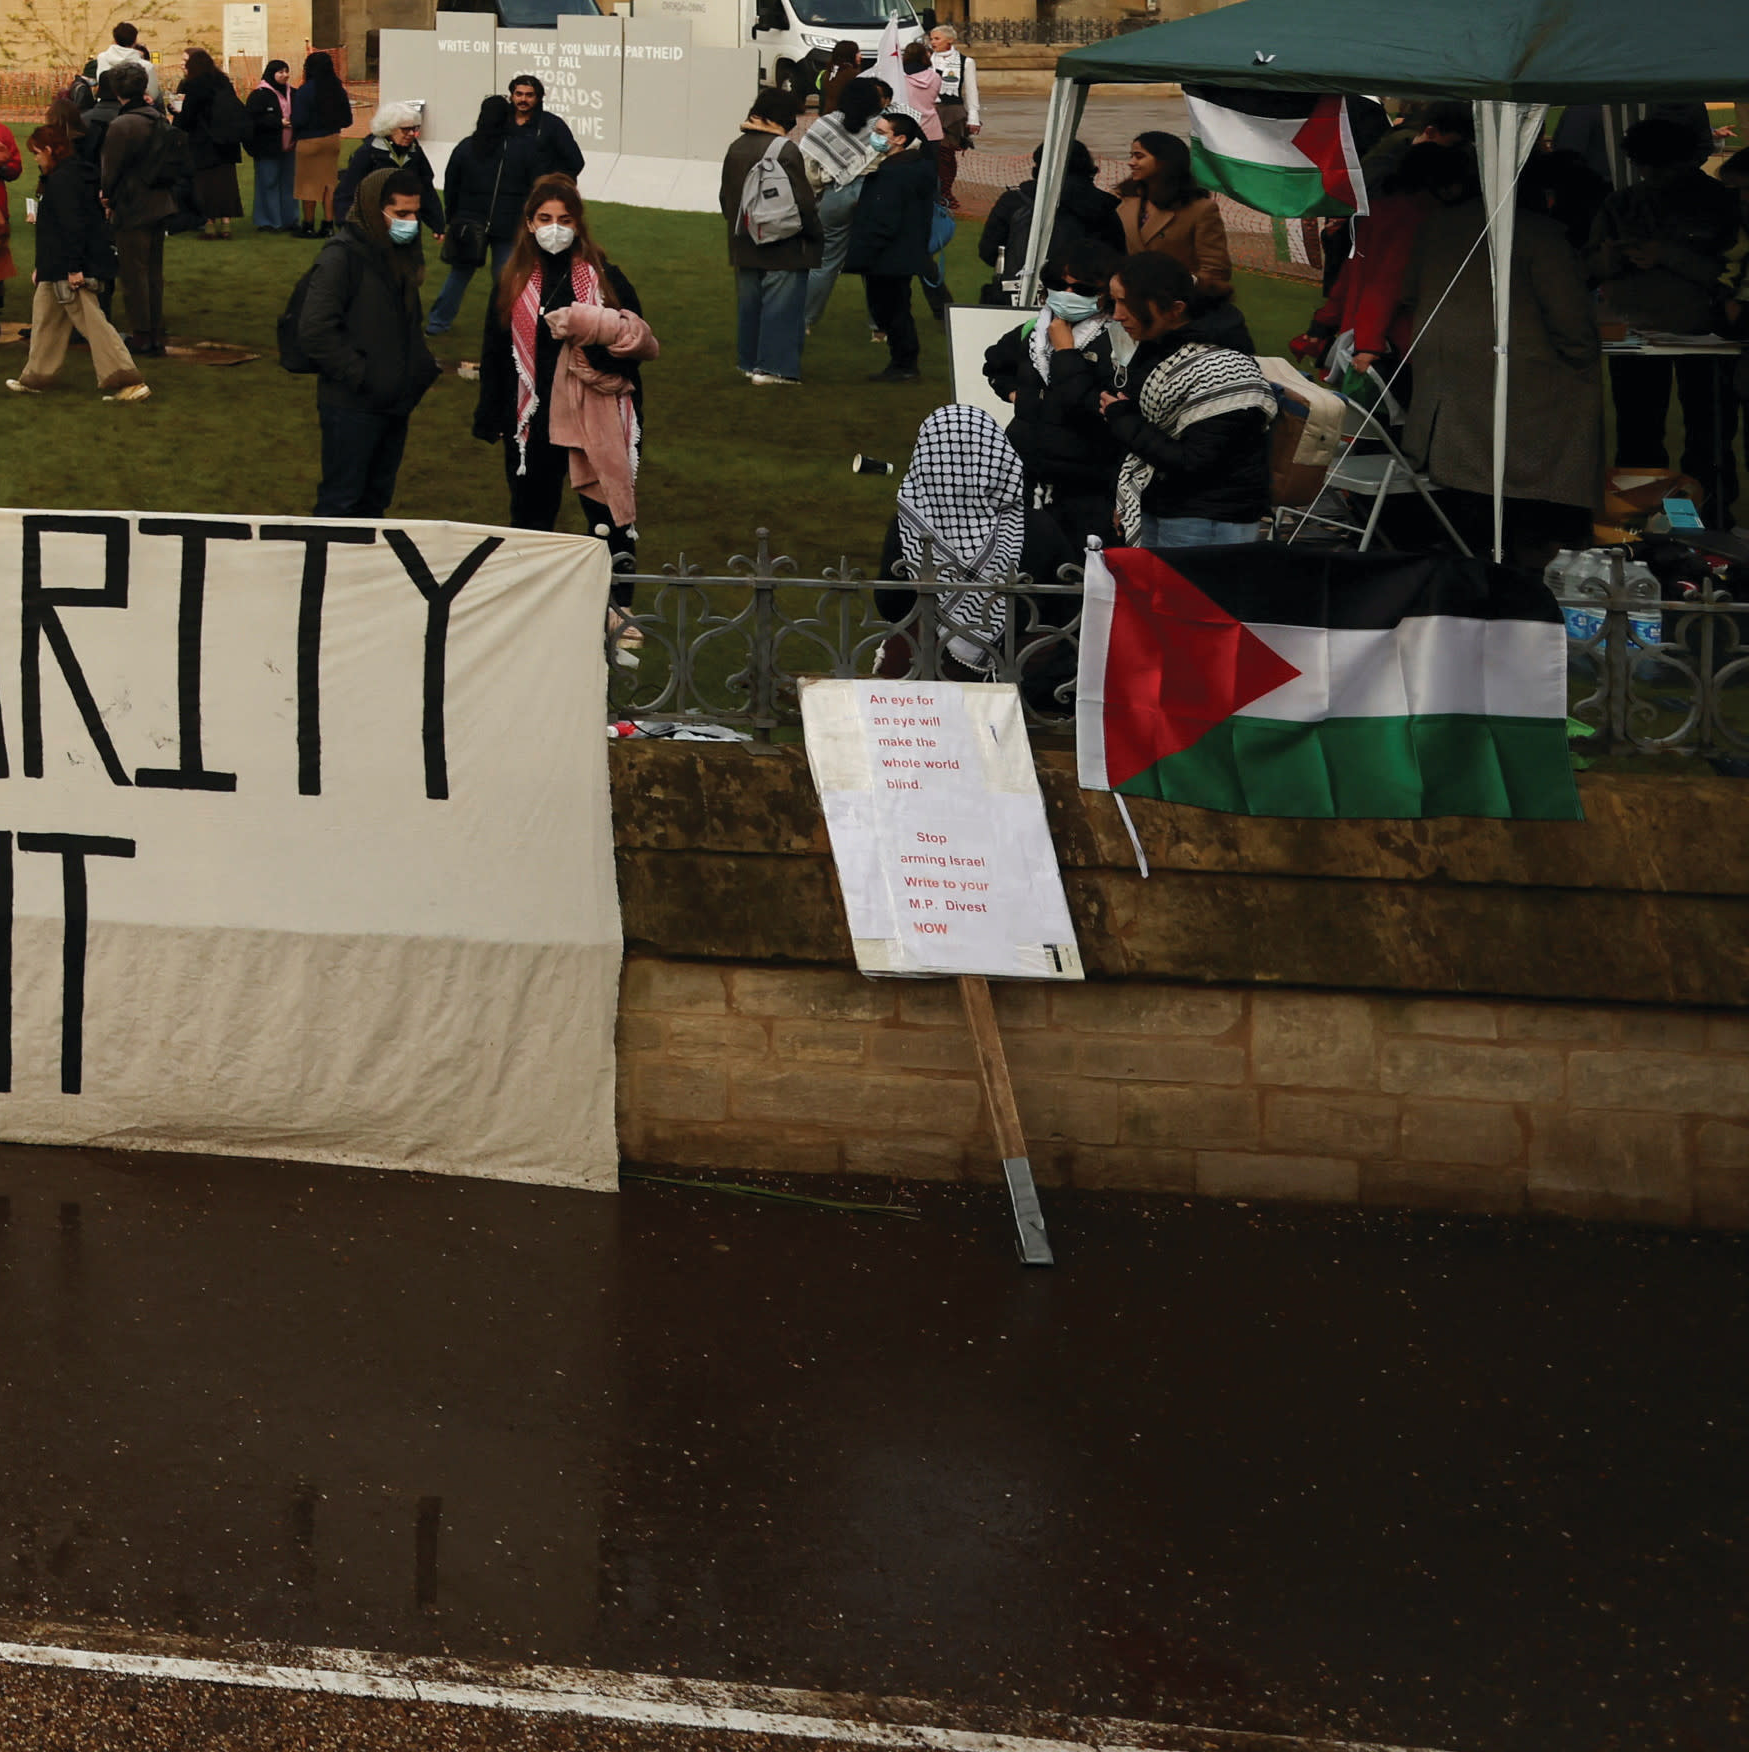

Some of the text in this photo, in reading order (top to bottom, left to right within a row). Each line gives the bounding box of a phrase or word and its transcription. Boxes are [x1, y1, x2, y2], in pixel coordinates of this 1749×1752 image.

[438, 39, 470, 53] WRITE
[473, 40, 490, 54] ON
[496, 41, 518, 55] THE
[519, 41, 545, 55] WALL
[546, 41, 554, 55] IF
[560, 43, 581, 56] YOU
[583, 44, 610, 57] WANT
[534, 55, 582, 68] TO FALL
[869, 694, 935, 707] An eye for
[873, 716, 941, 728] an eye will
[878, 736, 937, 748] make the
[882, 757, 960, 770] whole world
[886, 778, 923, 790] blind.
[916, 832, 947, 845] Stop
[900, 854, 985, 868] arming Israel
[904, 876, 990, 893] Write to your
[909, 898, 988, 913] M.P. Divest
[912, 922, 948, 935] NOW
